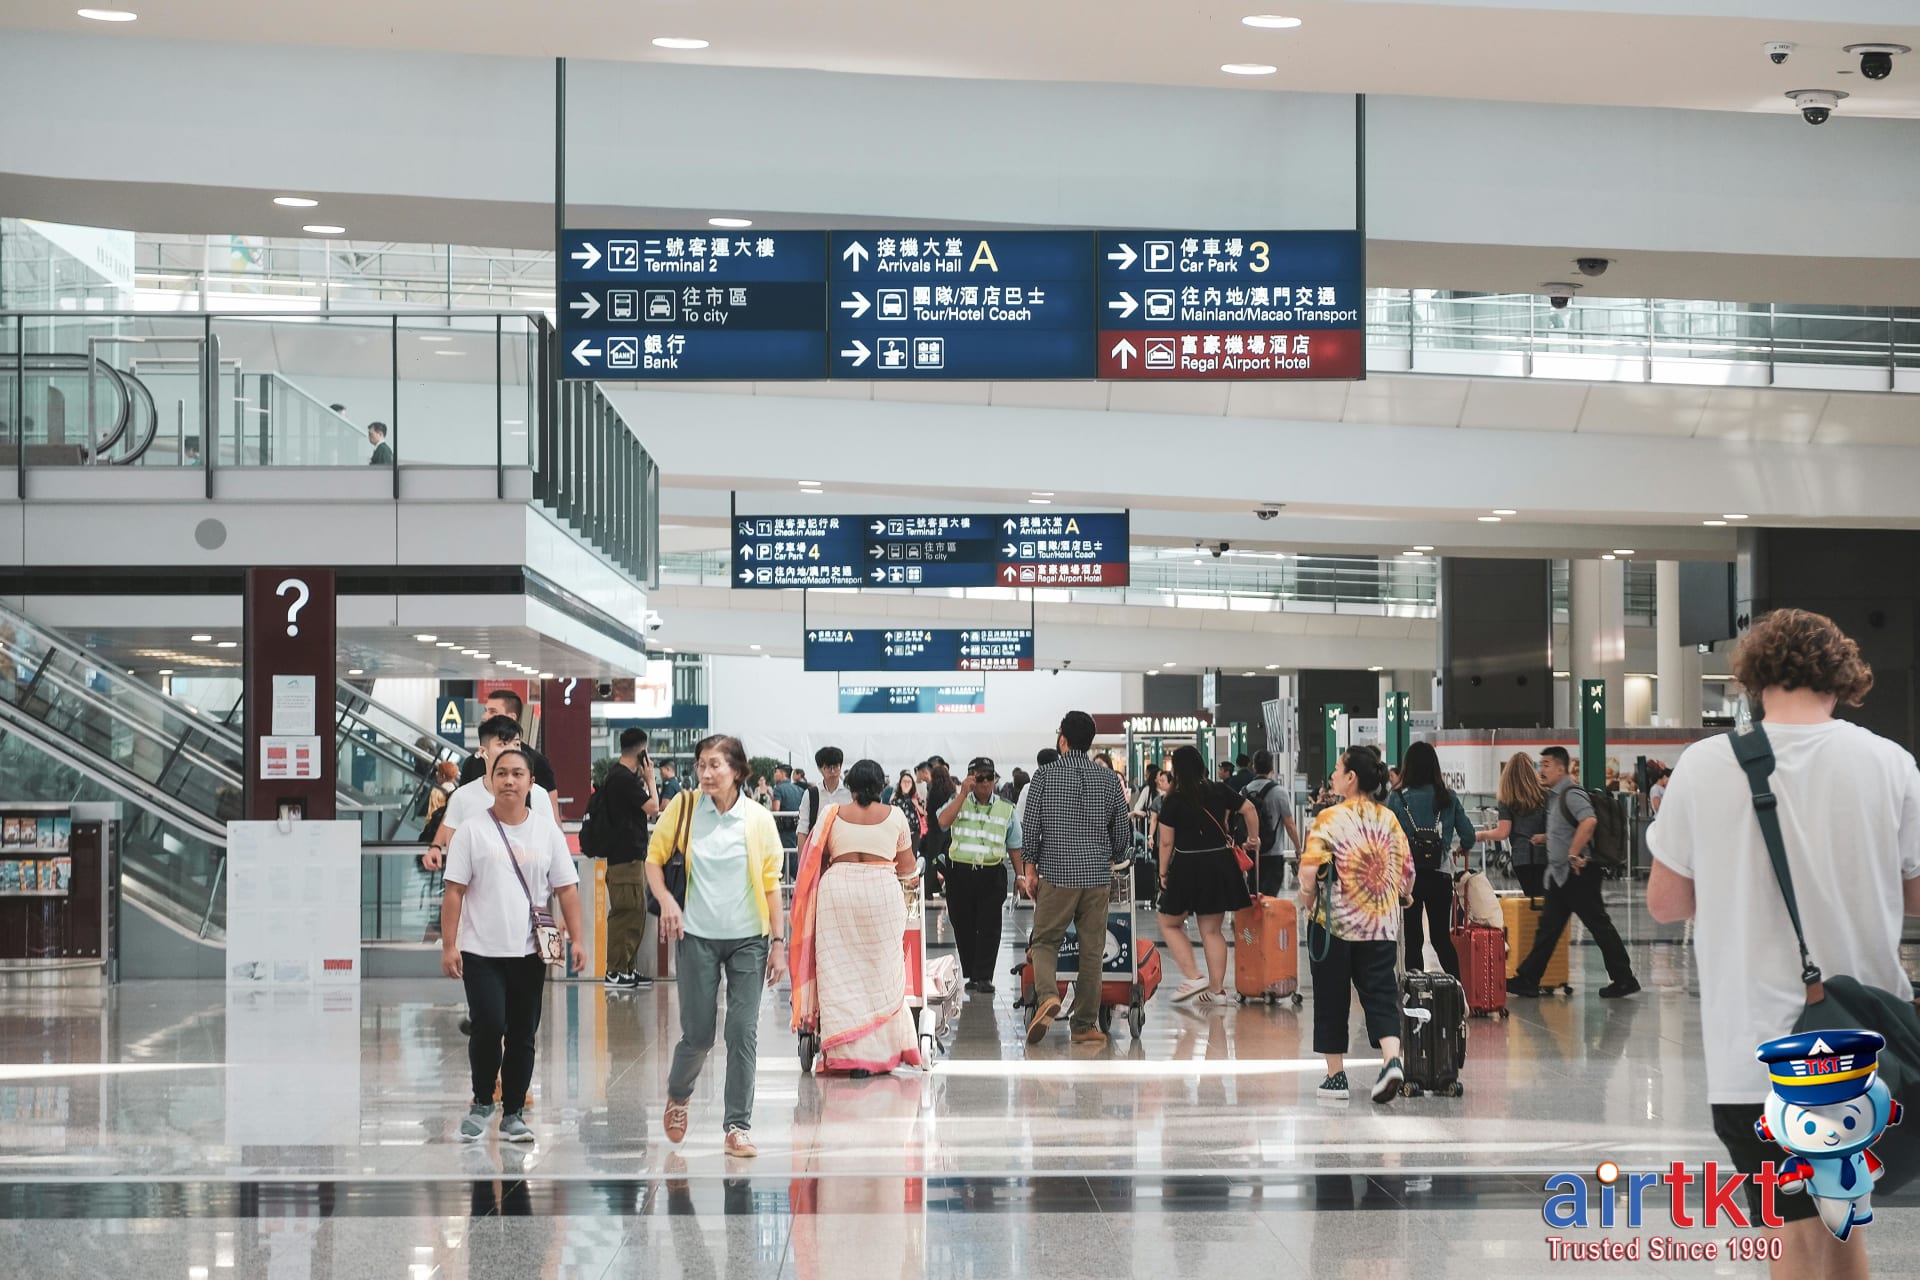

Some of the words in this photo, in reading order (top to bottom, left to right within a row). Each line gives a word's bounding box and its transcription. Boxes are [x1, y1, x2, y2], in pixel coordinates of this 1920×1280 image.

[612, 246, 636, 265] T2
[644, 238, 775, 258] 二號客運大樓
[878, 238, 963, 257] 接機大堂
[1180, 238, 1243, 257] 停車場
[969, 241, 999, 272] A
[1150, 245, 1168, 268] P
[1249, 241, 1270, 273] 3
[644, 258, 704, 272] Terminal
[709, 258, 717, 272] 2
[878, 259, 931, 272] Arrivals
[936, 259, 961, 272] Hall
[1180, 259, 1203, 272] Car
[1208, 259, 1237, 272] Park
[682, 287, 747, 306] 往市區
[913, 286, 1044, 306] 團隊/酒店巴士
[1181, 286, 1336, 306] 往內地/澳門交通
[682, 308, 698, 322] To
[704, 308, 728, 324] city
[914, 307, 984, 321] Tour/Hotel
[989, 307, 1031, 321] Coach
[1181, 308, 1292, 321] Mainland/Macao
[1294, 308, 1357, 323] Transport
[644, 334, 686, 354] 銀行
[1181, 335, 1310, 355] 富豪機場酒店
[644, 355, 678, 369] Bank
[1181, 356, 1218, 372] Regal
[1223, 356, 1270, 372] Airport
[1275, 356, 1310, 369] Hotel
[758, 523, 770, 532] T1
[890, 522, 902, 532] T2
[1065, 518, 1080, 535] A
[759, 545, 770, 558] P
[808, 544, 820, 560] 4
[924, 542, 956, 552] 往市區
[935, 552, 947, 561] city
[831, 577, 862, 585] Transport
[1038, 574, 1056, 584] Regal
[1058, 574, 1082, 584] Airport
[275, 578, 310, 637] ?
[844, 631, 853, 642] A
[925, 632, 932, 642] 4
[441, 701, 462, 723] A
[1131, 717, 1152, 732] PRET
[1154, 717, 1160, 732] A
